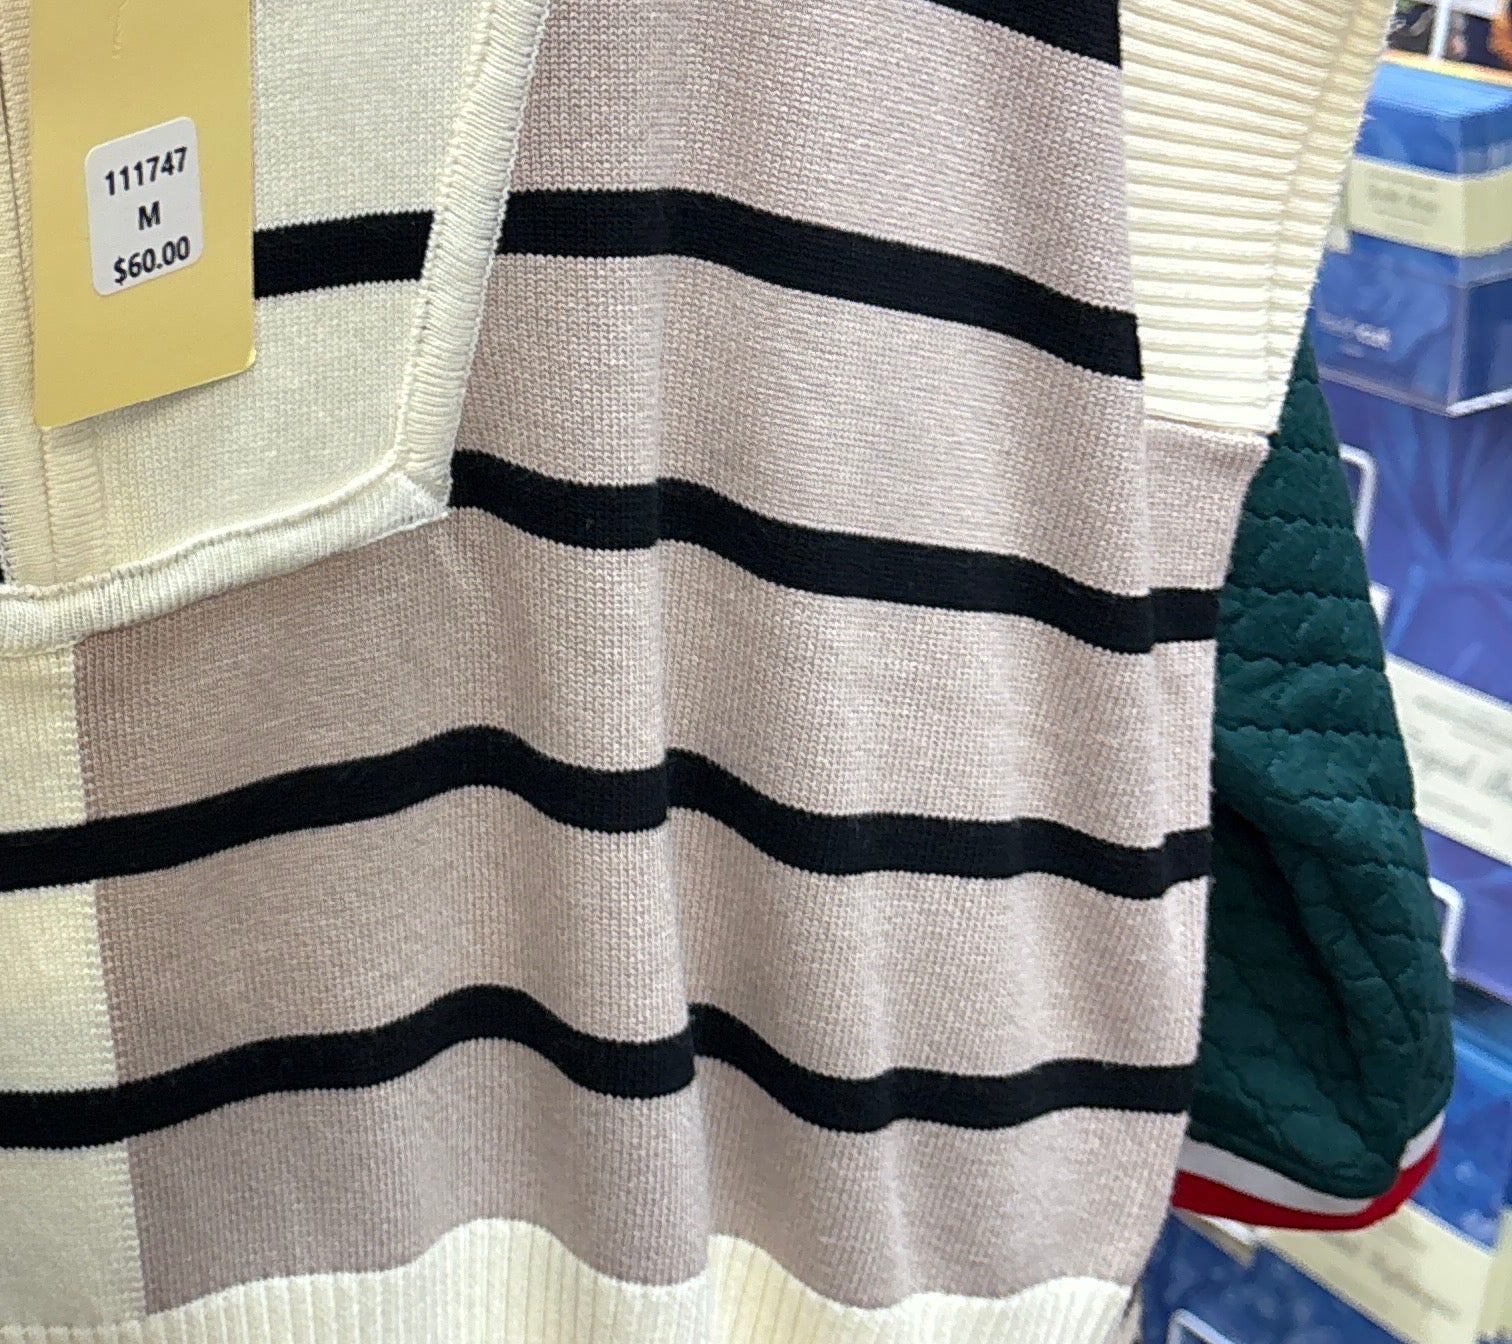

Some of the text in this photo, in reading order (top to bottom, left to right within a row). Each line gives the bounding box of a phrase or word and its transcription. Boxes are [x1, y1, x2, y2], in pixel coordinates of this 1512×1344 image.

[105, 146, 188, 196] 111747
[138, 200, 161, 231] M
[113, 235, 190, 286] $60.00
